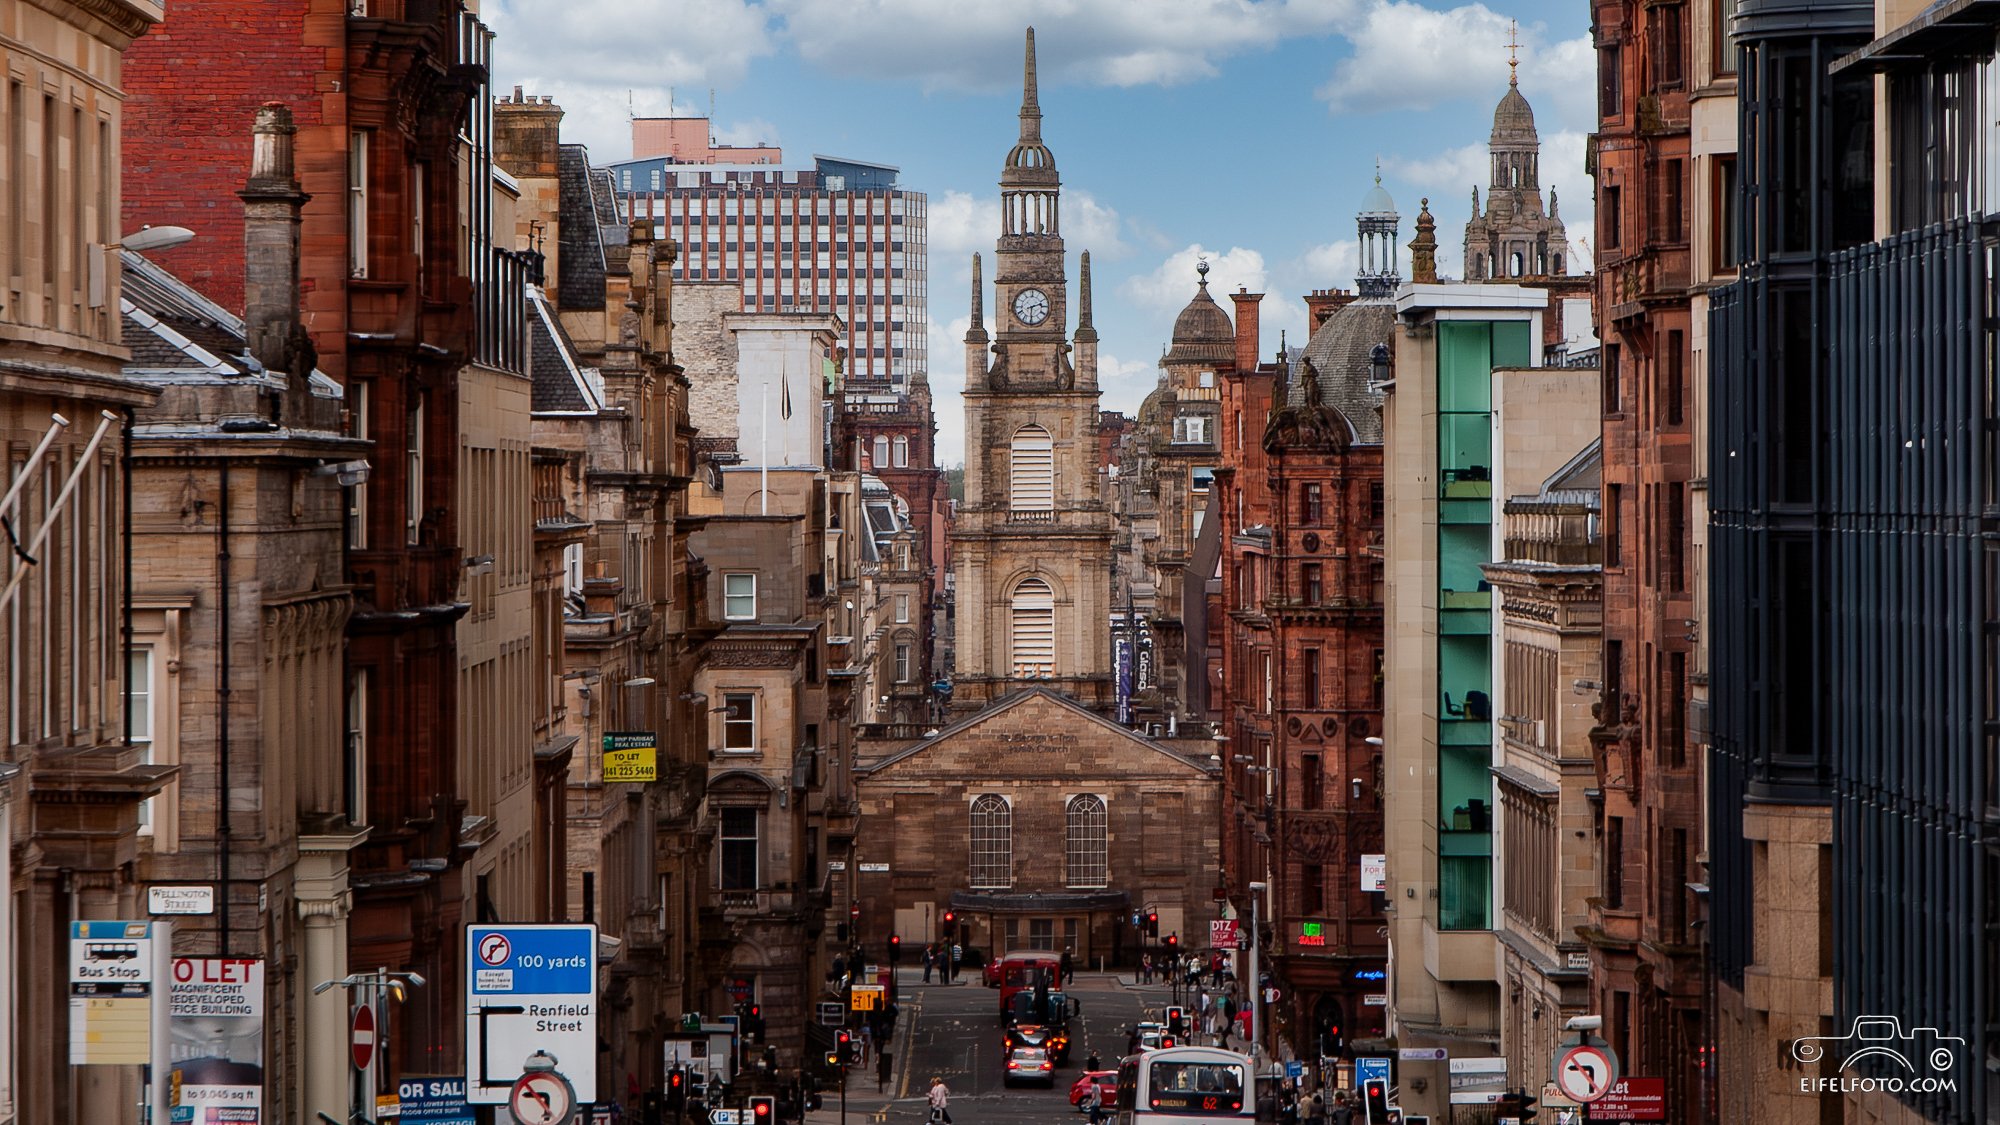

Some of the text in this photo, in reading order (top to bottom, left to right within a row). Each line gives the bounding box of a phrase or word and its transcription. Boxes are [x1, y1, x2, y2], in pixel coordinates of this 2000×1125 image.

[151, 888, 211, 899] WELLINGTON
[164, 899, 198, 908] STREET
[1211, 920, 1231, 931] DTZ
[518, 955, 587, 970] 100 yards
[79, 966, 141, 980] Bus Stop
[203, 959, 256, 983] LET
[201, 1005, 252, 1015] BUILDING
[529, 1005, 589, 1017] Renfield
[536, 1020, 582, 1032] Street
[187, 1090, 197, 1098] to
[399, 1083, 425, 1099] OR
[1203, 1096, 1217, 1110] 62
